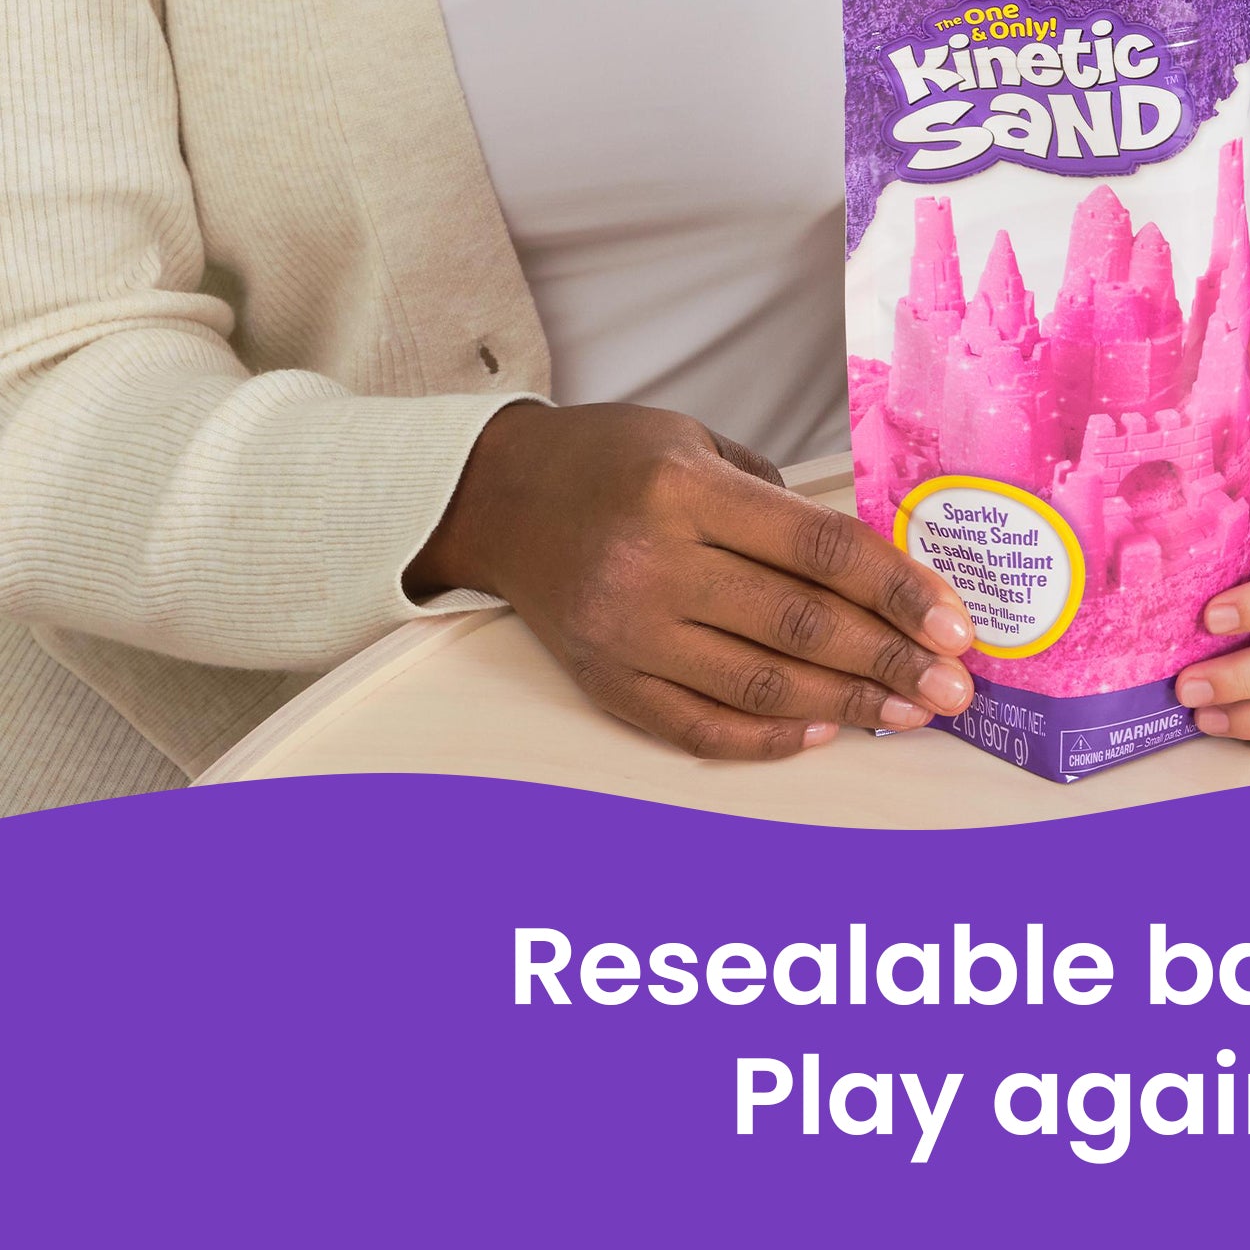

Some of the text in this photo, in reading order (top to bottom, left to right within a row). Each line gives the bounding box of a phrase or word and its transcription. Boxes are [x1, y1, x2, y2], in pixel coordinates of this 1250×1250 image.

[934, 3, 1019, 31] The One
[971, 18, 1057, 42] & Only!
[943, 503, 1008, 527] Sparkly
[925, 521, 1039, 546] Flowing Sand!
[920, 537, 1053, 570] Le sable brillant
[933, 557, 1047, 587] qui coule entre
[952, 575, 975, 591] tes
[960, 597, 1035, 624] rena brillante
[971, 614, 1020, 634] que fluye!
[963, 710, 975, 739] lb
[980, 715, 1010, 753] (907
[1014, 732, 1029, 766] g)
[1109, 713, 1183, 746] WARNING:
[1069, 751, 1104, 767] CHOKING
[1105, 742, 1135, 761] HAZARD
[1144, 734, 1163, 748] Small
